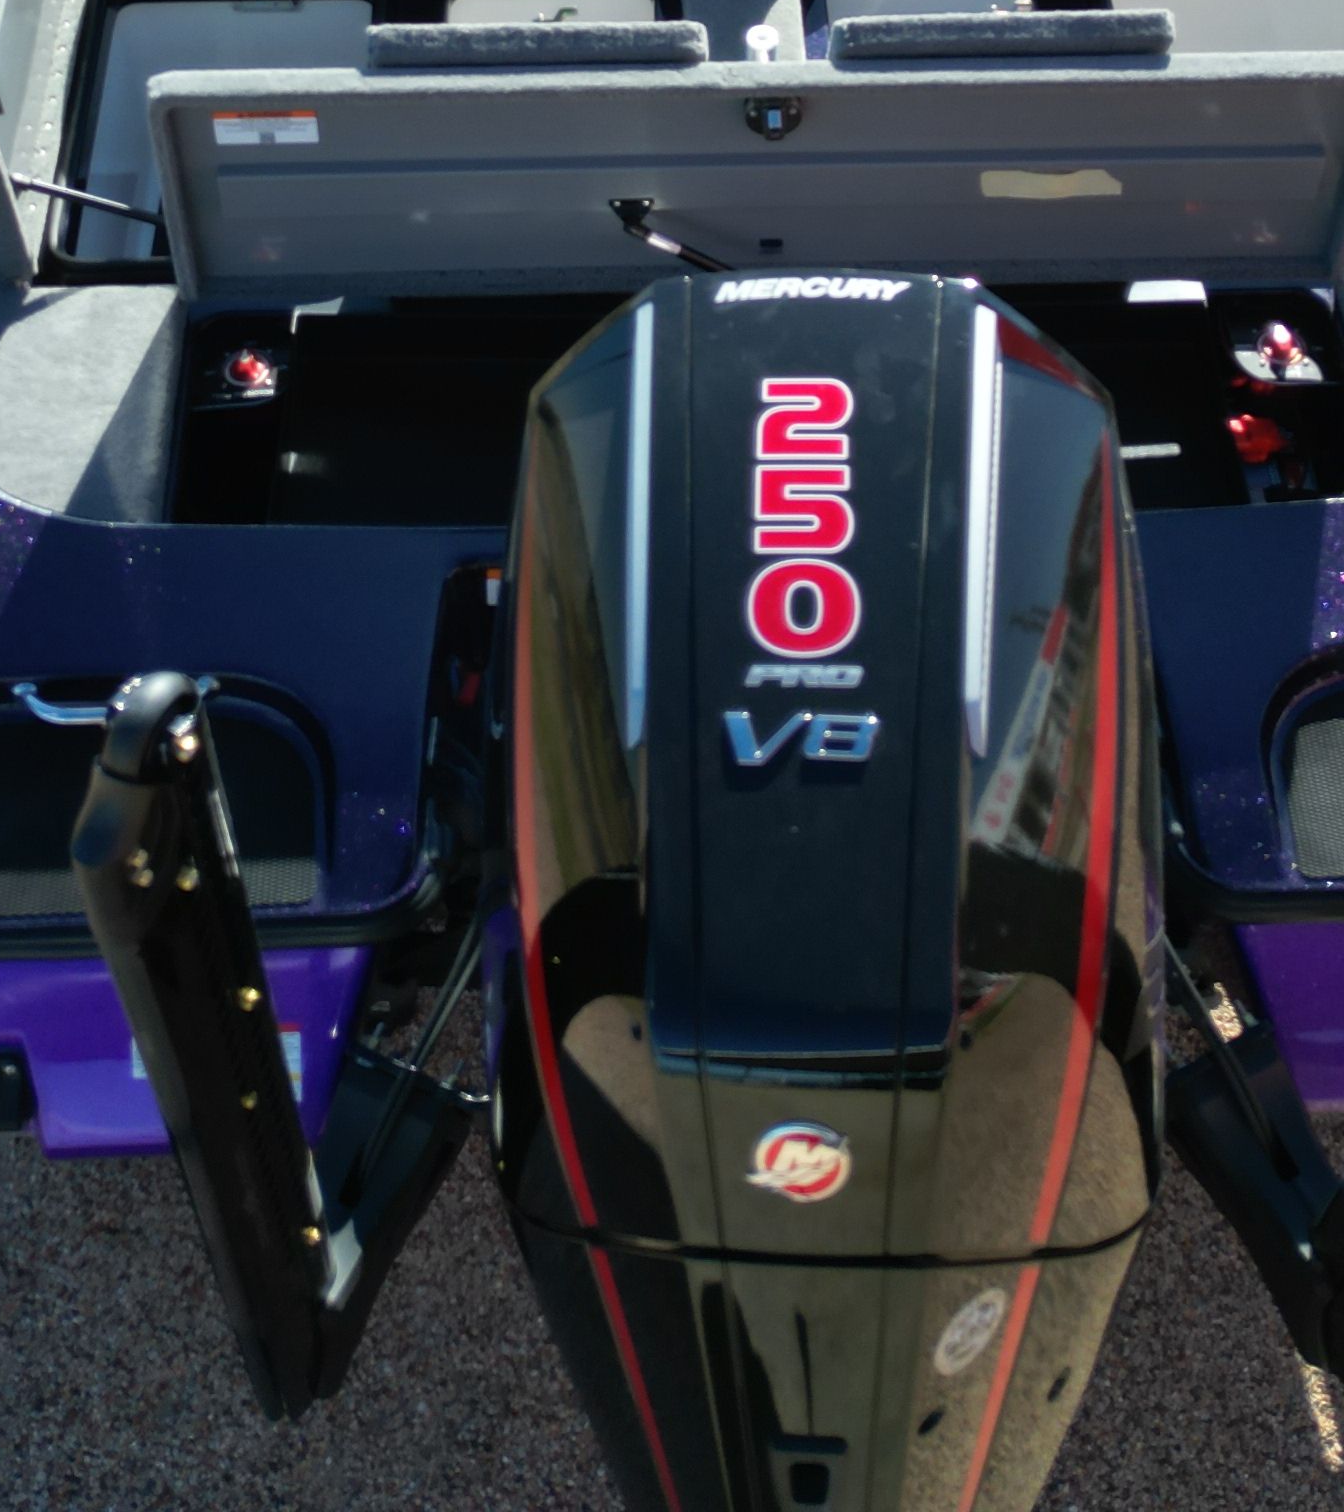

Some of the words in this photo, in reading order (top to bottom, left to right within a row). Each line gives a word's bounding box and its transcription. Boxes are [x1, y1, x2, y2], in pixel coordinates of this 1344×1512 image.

[714, 276, 912, 304] MERCURY
[747, 377, 862, 659] 250
[744, 664, 865, 689] PRO
[723, 710, 880, 767] V8
